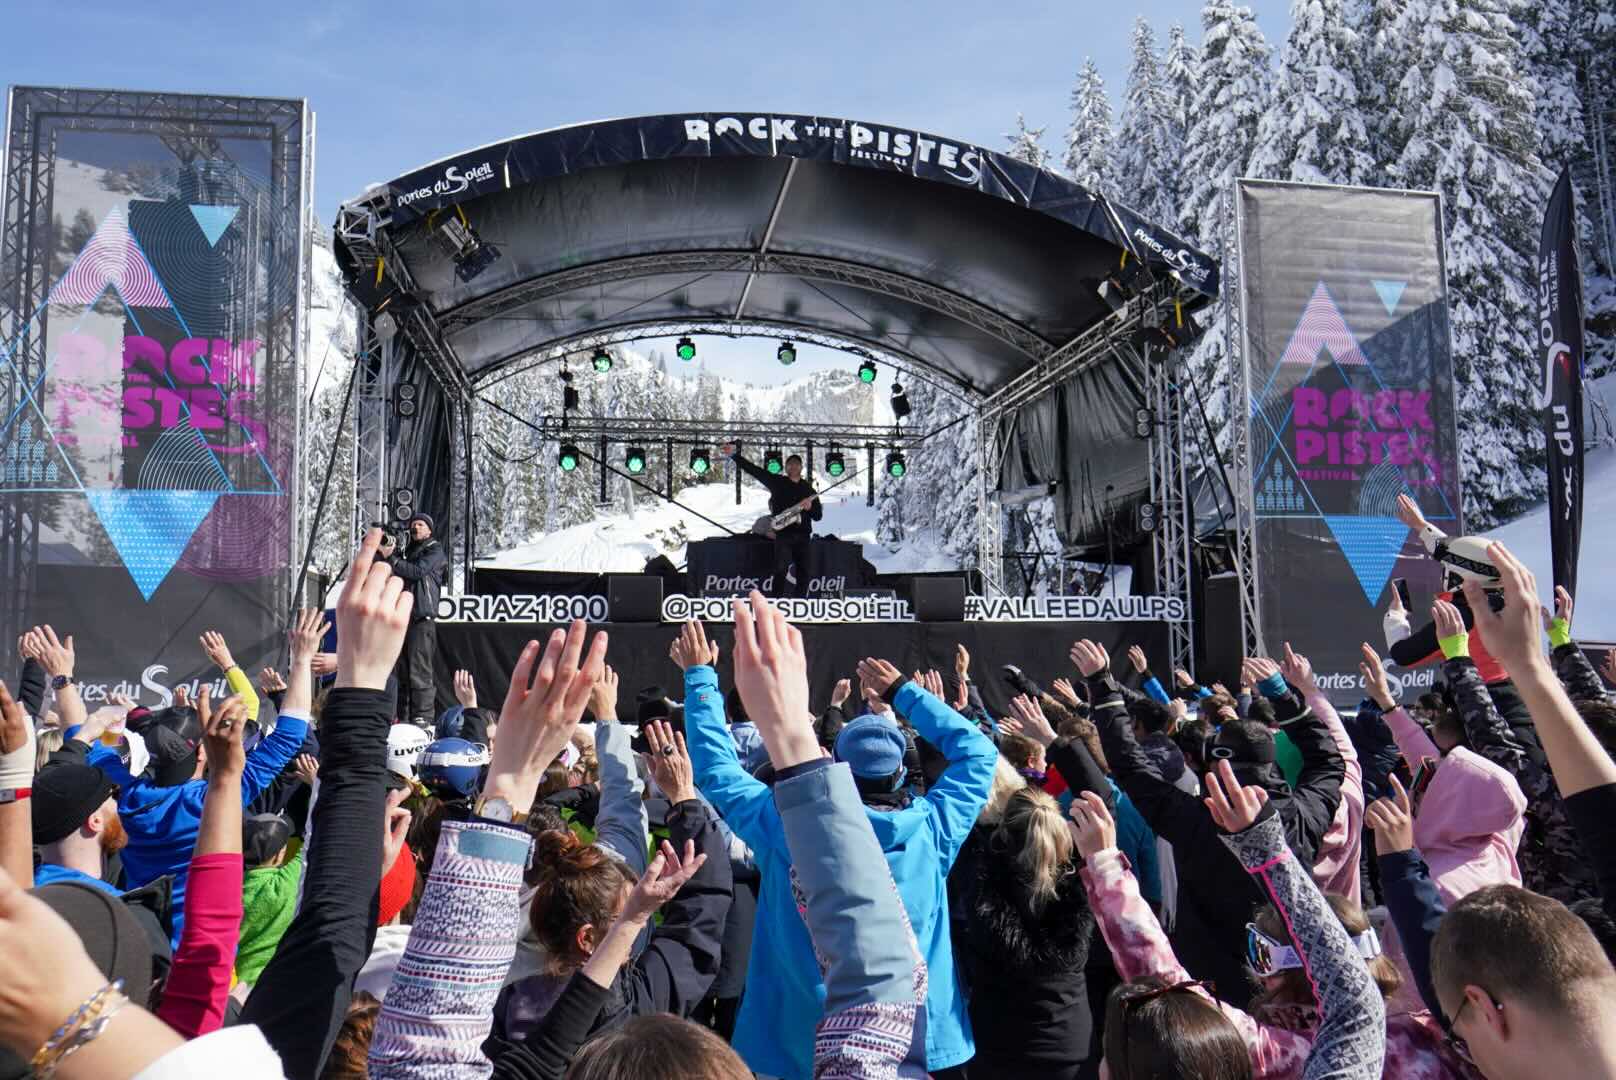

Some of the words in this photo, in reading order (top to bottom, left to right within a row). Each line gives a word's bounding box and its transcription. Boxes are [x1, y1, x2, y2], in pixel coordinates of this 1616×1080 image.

[684, 117, 799, 142] ROCK
[805, 124, 845, 140] THE
[850, 122, 981, 185] PISTES
[434, 178, 450, 194] du
[440, 162, 492, 195] Soleil
[397, 186, 433, 208] Portes
[1134, 228, 1163, 254] Portes
[55, 384, 269, 453] STES
[1293, 387, 1435, 430] ROCK
[1296, 428, 1442, 486] PISTES
[705, 574, 759, 592] Portes
[665, 599, 913, 620] @POTSDUSOLEIL
[964, 598, 1183, 620] #VALLEEDAULPS
[141, 664, 229, 711] Solil
